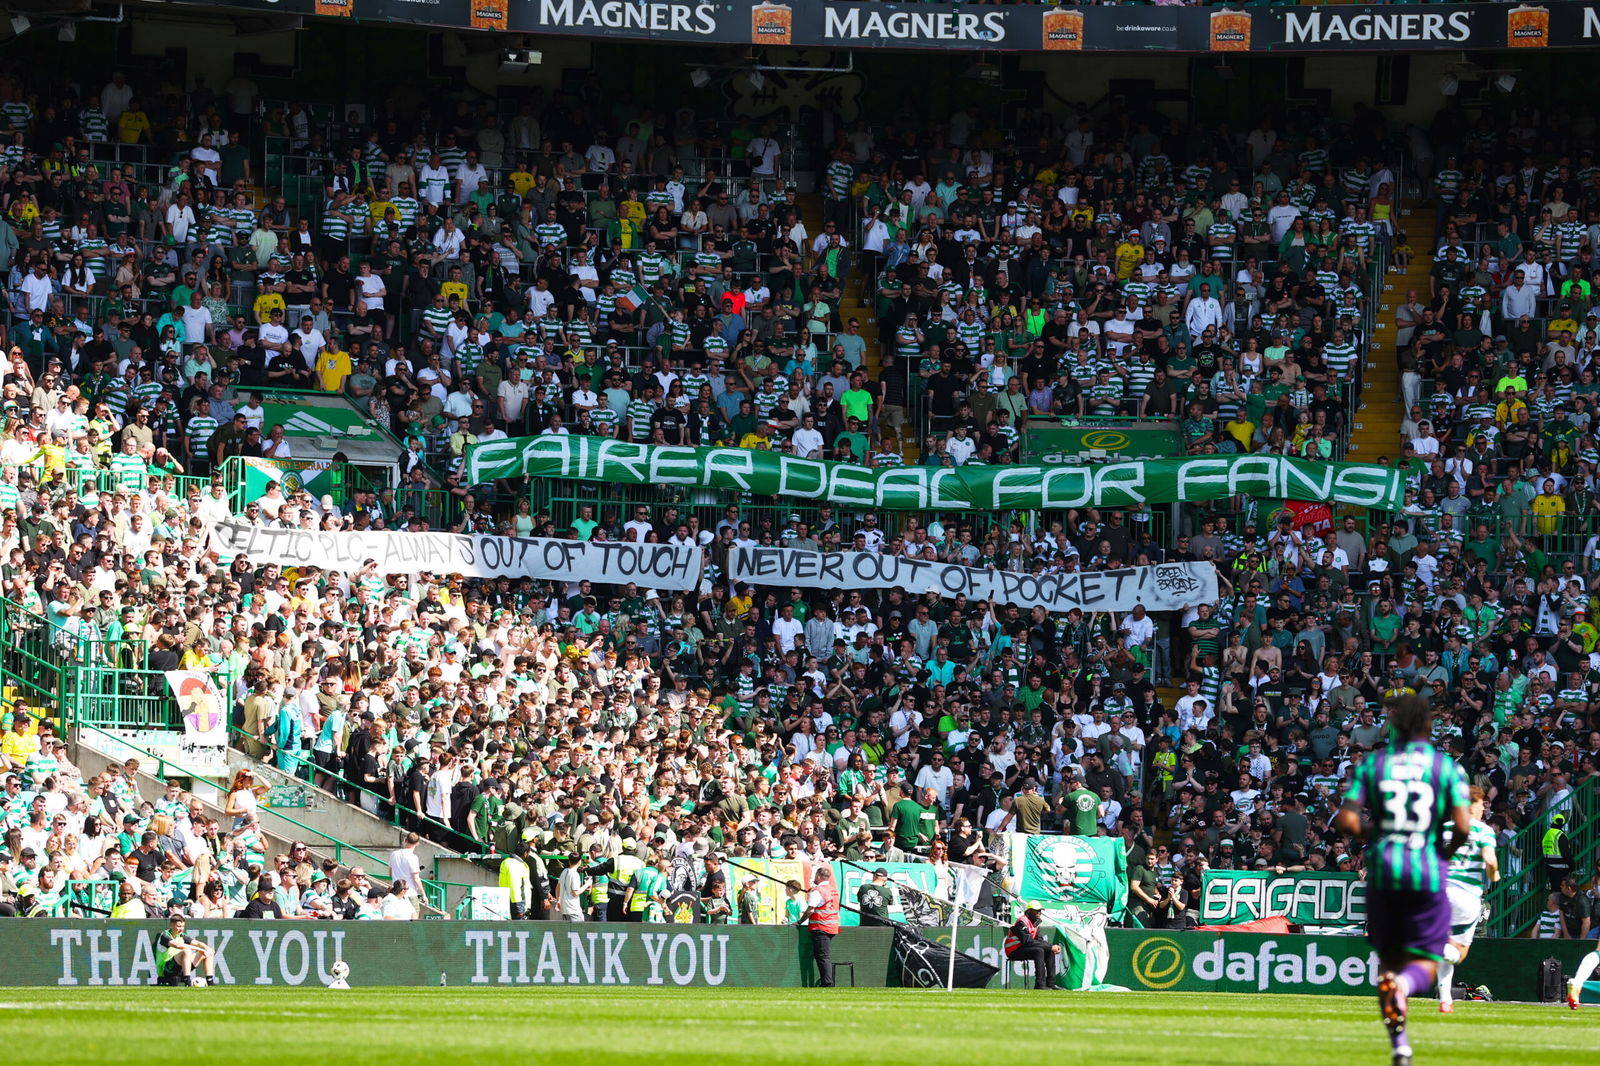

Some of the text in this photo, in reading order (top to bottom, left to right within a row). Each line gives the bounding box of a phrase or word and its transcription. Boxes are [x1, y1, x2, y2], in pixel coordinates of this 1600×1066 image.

[476, 11, 502, 19] MAGNERS
[539, 0, 717, 35] MAGNERS
[758, 27, 785, 35] MAGNERS
[824, 7, 1006, 42] MAGNERS
[1285, 11, 1471, 42] MAGNERS
[1514, 29, 1542, 37] MAGNERS
[1048, 32, 1077, 40] MAGNERS
[1216, 33, 1244, 41] MAGNERS
[470, 435, 753, 491] FAIRER
[993, 461, 1145, 509] FOR
[1177, 456, 1401, 510] FANS!
[319, 531, 364, 563] PLC
[384, 533, 475, 566] ALWAYS
[480, 537, 539, 570] OUT
[543, 541, 586, 573] OF
[592, 542, 693, 579] TOUCH
[736, 551, 1149, 603] NEVER OUT OF POCKET!
[1378, 779, 1435, 832] 33
[1203, 877, 1369, 921] BRIGADE
[50, 929, 347, 986] THAK YOU
[464, 930, 730, 986] THANK YOU
[1192, 938, 1381, 991] dafabet
